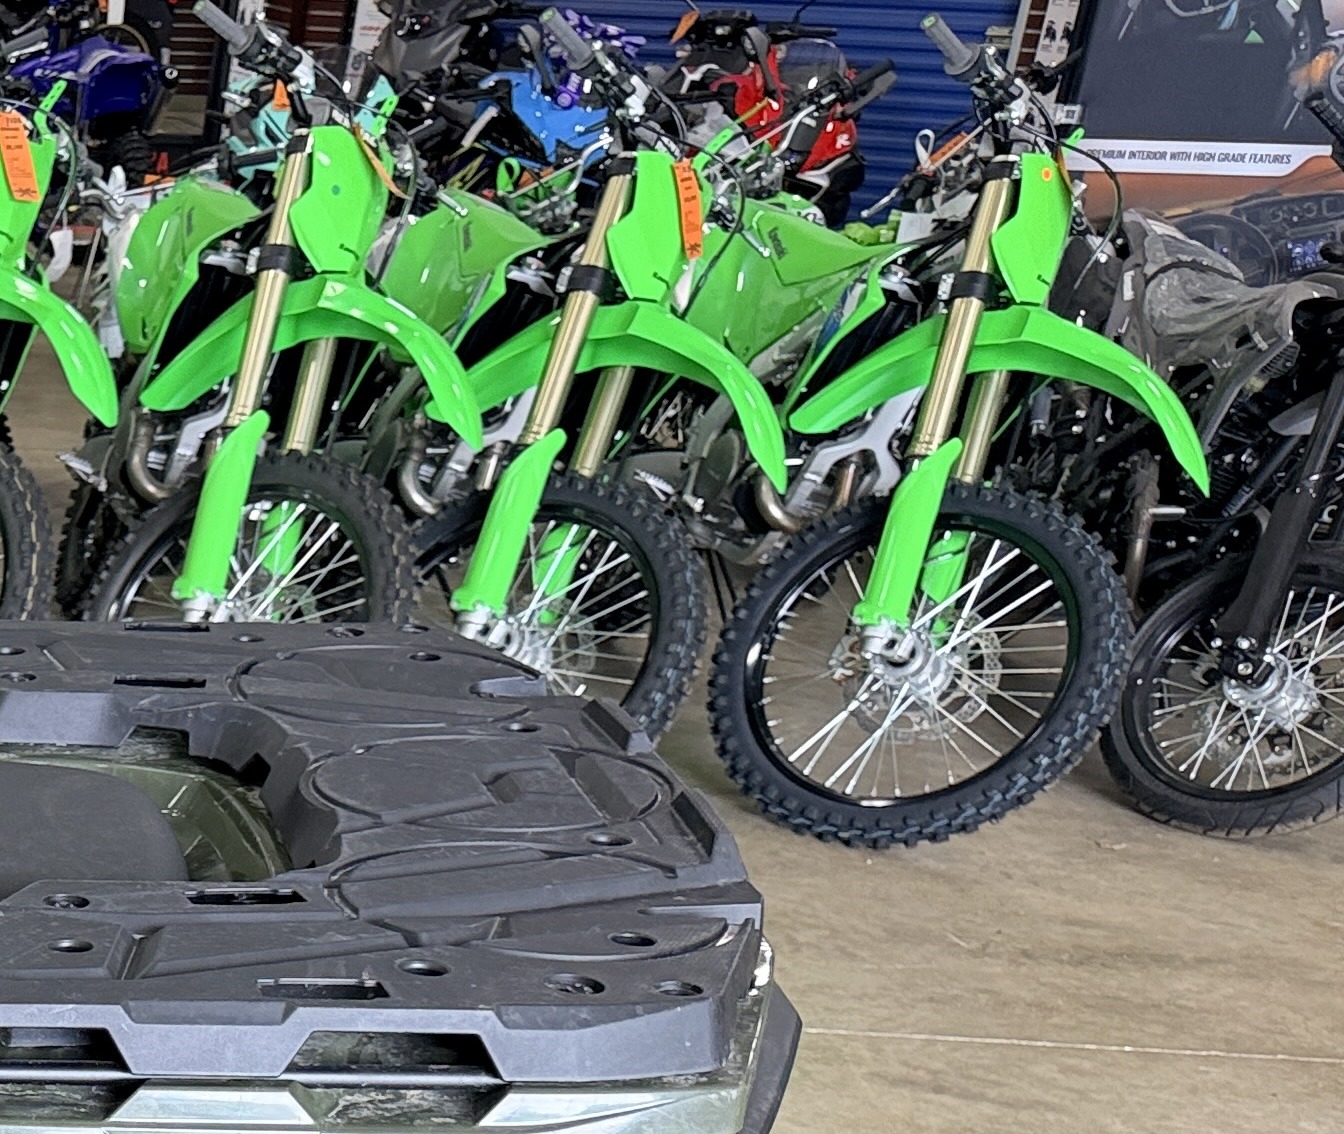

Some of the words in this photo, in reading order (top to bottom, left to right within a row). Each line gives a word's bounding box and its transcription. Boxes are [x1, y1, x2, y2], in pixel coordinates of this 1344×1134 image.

[1127, 150, 1167, 161] INTERIOR
[1169, 151, 1192, 161] WITH
[1193, 151, 1216, 162] HIGH
[1217, 152, 1248, 163] GRADE
[1248, 153, 1292, 164] FEATURES
